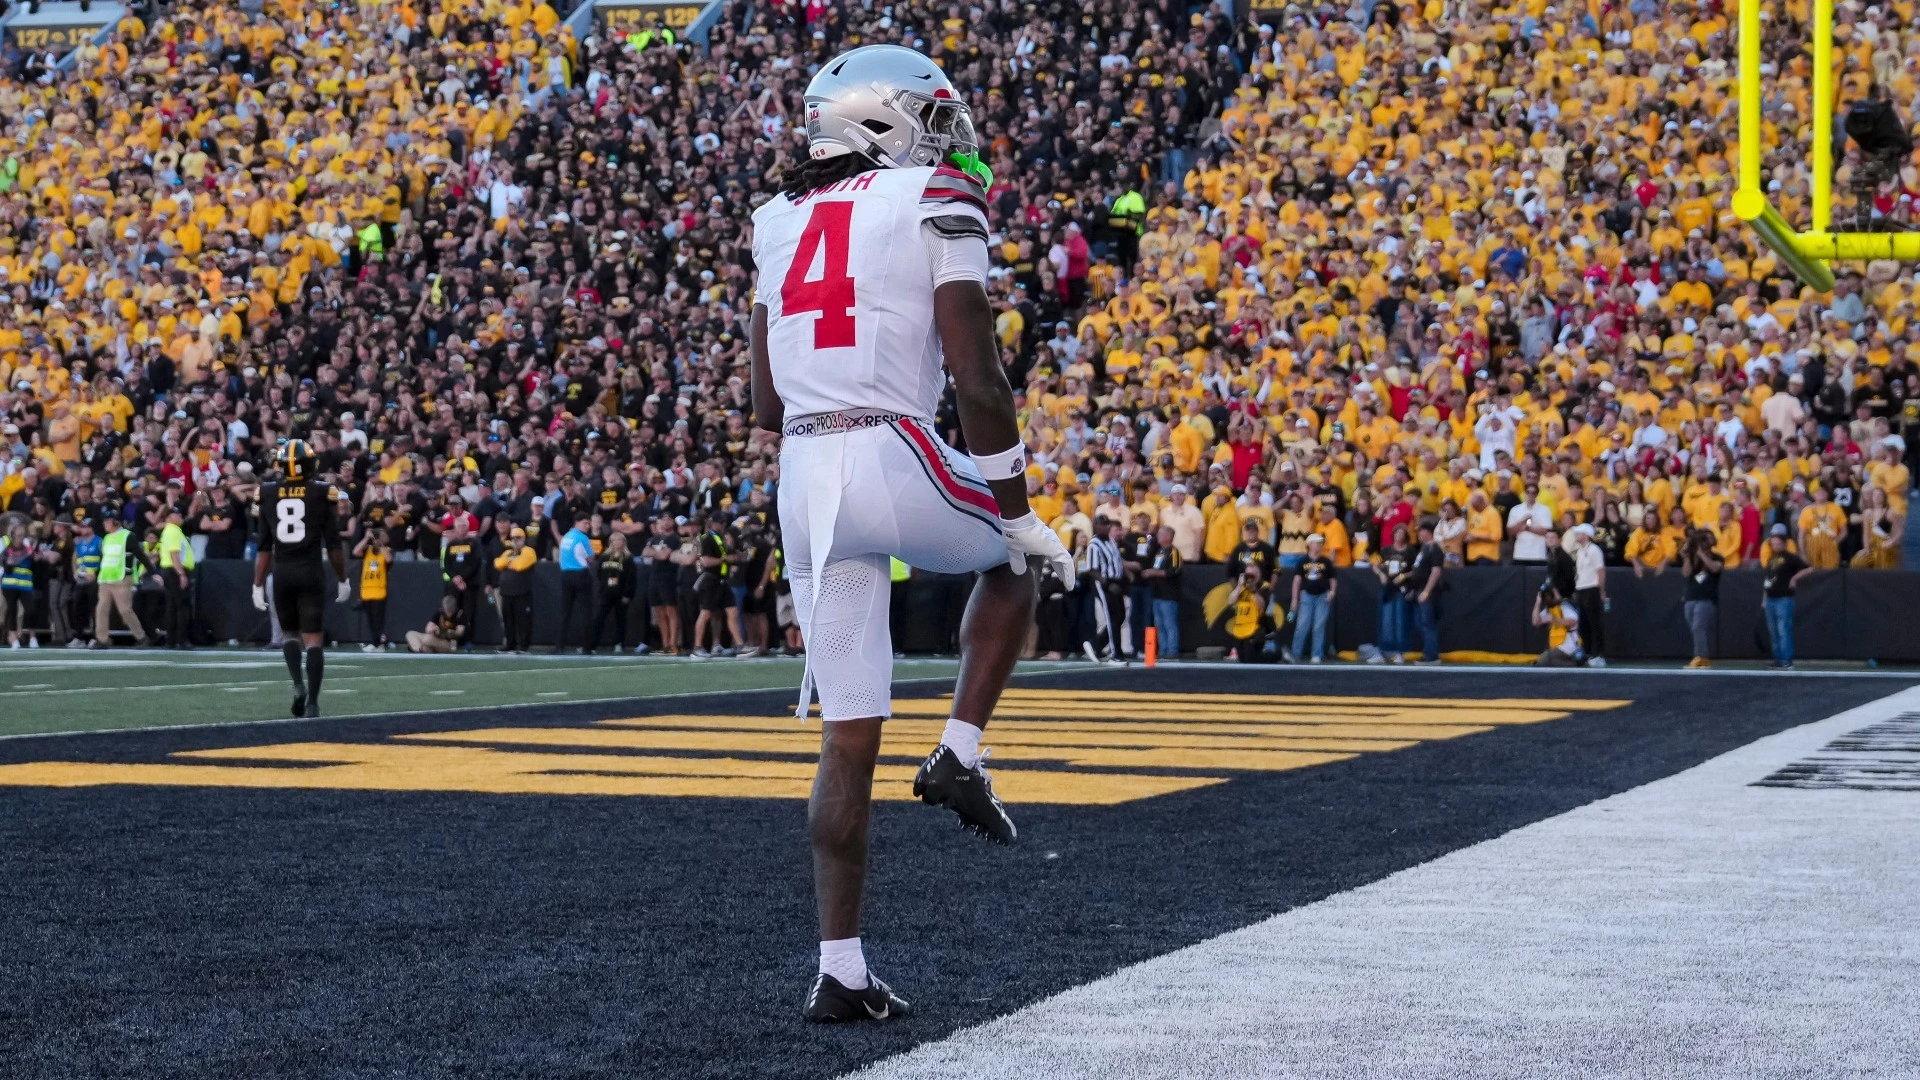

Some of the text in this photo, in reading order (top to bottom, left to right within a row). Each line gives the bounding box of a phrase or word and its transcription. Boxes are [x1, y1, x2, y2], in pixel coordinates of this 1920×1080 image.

[17, 29, 49, 48] 127
[781, 201, 856, 350] 4
[288, 487, 306, 498] LEE
[276, 498, 306, 543] 8
